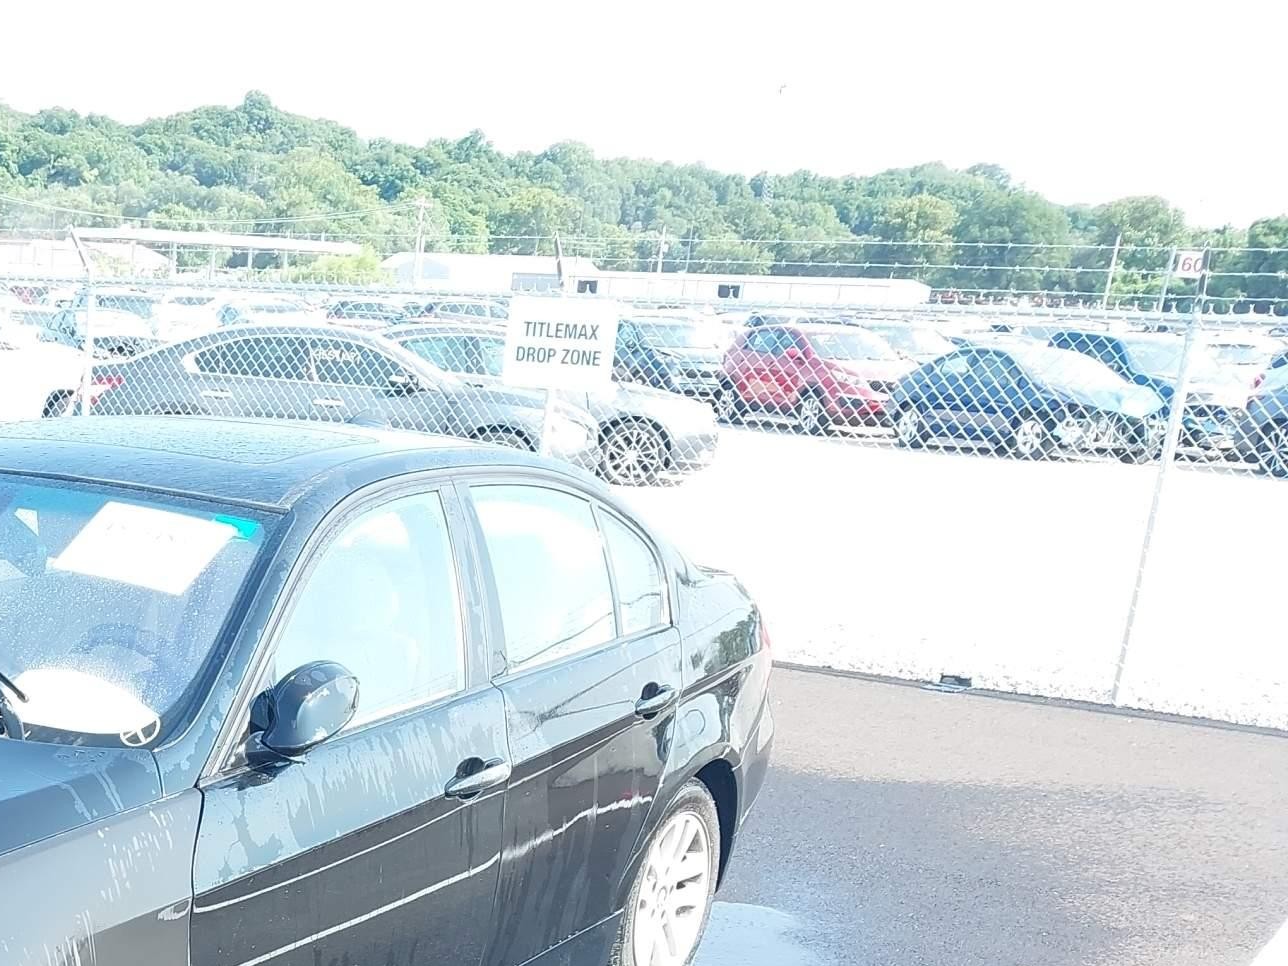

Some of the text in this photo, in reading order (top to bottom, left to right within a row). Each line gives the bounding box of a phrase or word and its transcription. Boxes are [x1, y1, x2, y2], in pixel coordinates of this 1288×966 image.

[524, 321, 599, 340] TITLEMAX
[516, 346, 602, 366] DROP ZONE
